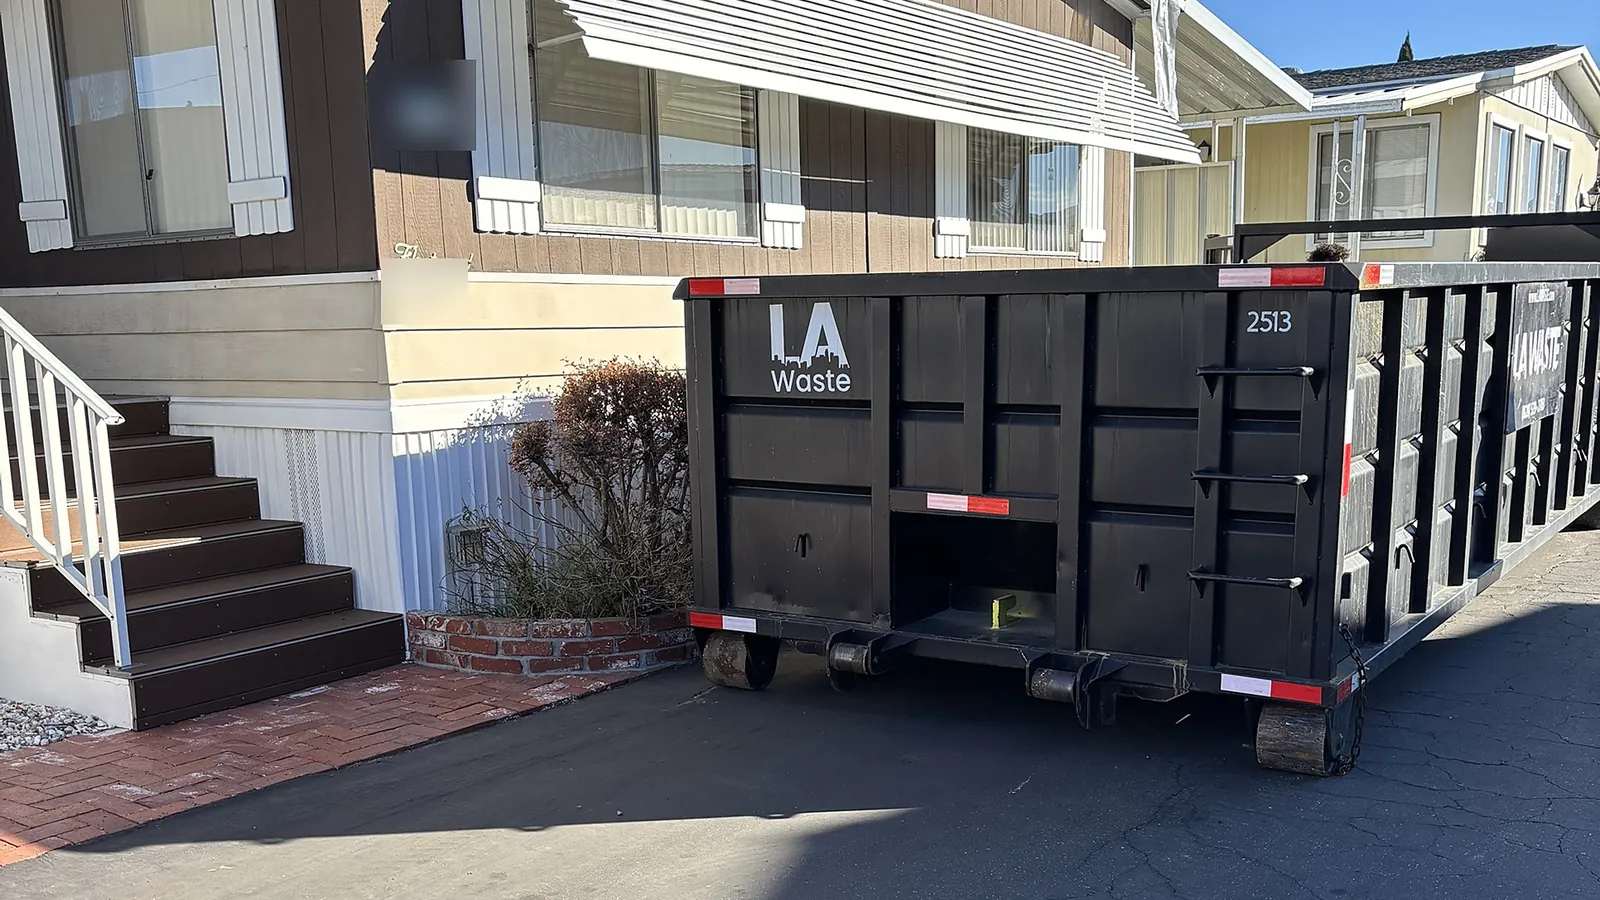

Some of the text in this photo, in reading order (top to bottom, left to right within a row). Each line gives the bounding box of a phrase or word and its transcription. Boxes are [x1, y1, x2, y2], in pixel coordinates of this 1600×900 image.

[769, 302, 850, 369] LA
[1246, 310, 1292, 333] 2513
[1512, 326, 1562, 381] LA WASTE
[770, 369, 851, 392] Waste
